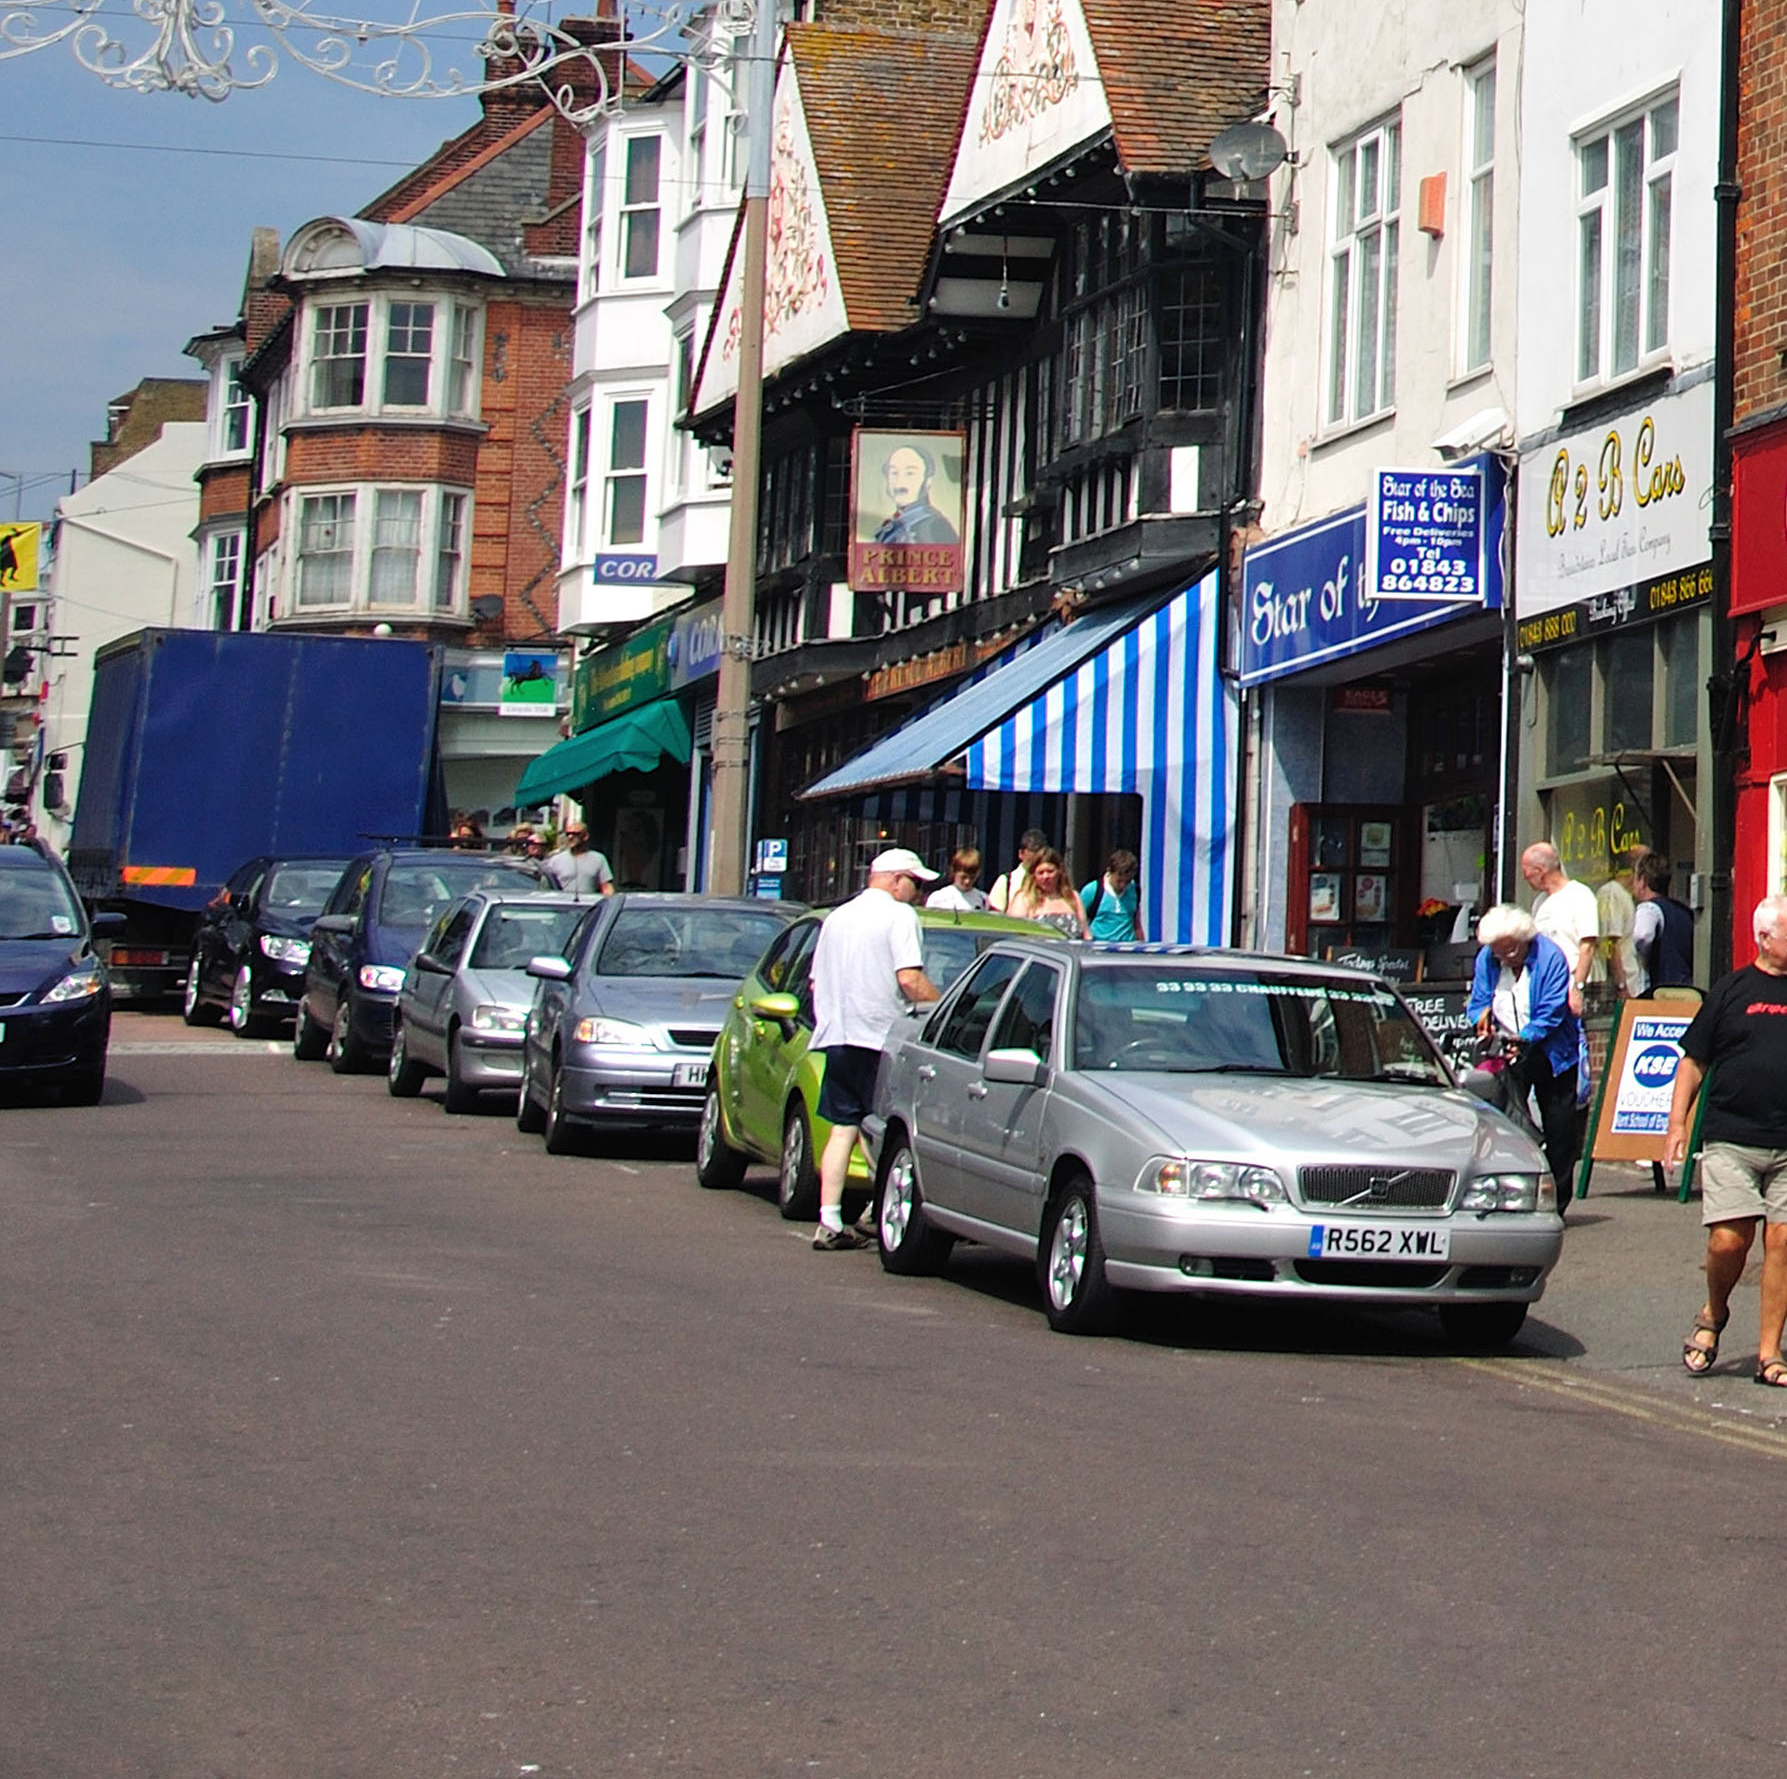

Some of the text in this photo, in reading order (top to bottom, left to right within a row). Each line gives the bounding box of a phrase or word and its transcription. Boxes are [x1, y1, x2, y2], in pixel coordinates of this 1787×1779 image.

[1573, 464, 1588, 531] 2
[1598, 430, 1623, 521] B
[1633, 416, 1686, 508] Cars
[1382, 475, 1411, 497] Star
[1414, 475, 1428, 497] of
[1383, 500, 1475, 527] Fish & Chips
[1383, 525, 1475, 538] Free Deliveries
[862, 548, 955, 568] PRINCE
[1416, 546, 1441, 560] Tel
[600, 560, 657, 578] COR
[859, 567, 955, 585] ALBERT
[1390, 559, 1466, 576] 01843
[1382, 575, 1475, 593] 864823
[1252, 581, 1311, 646] Star
[1320, 555, 1349, 621] of
[769, 841, 782, 857] P
[1405, 997, 1446, 1013] FREE
[1636, 1023, 1654, 1038] We
[1634, 1056, 1678, 1075] KSE
[1327, 1227, 1443, 1254] R562 XWL
